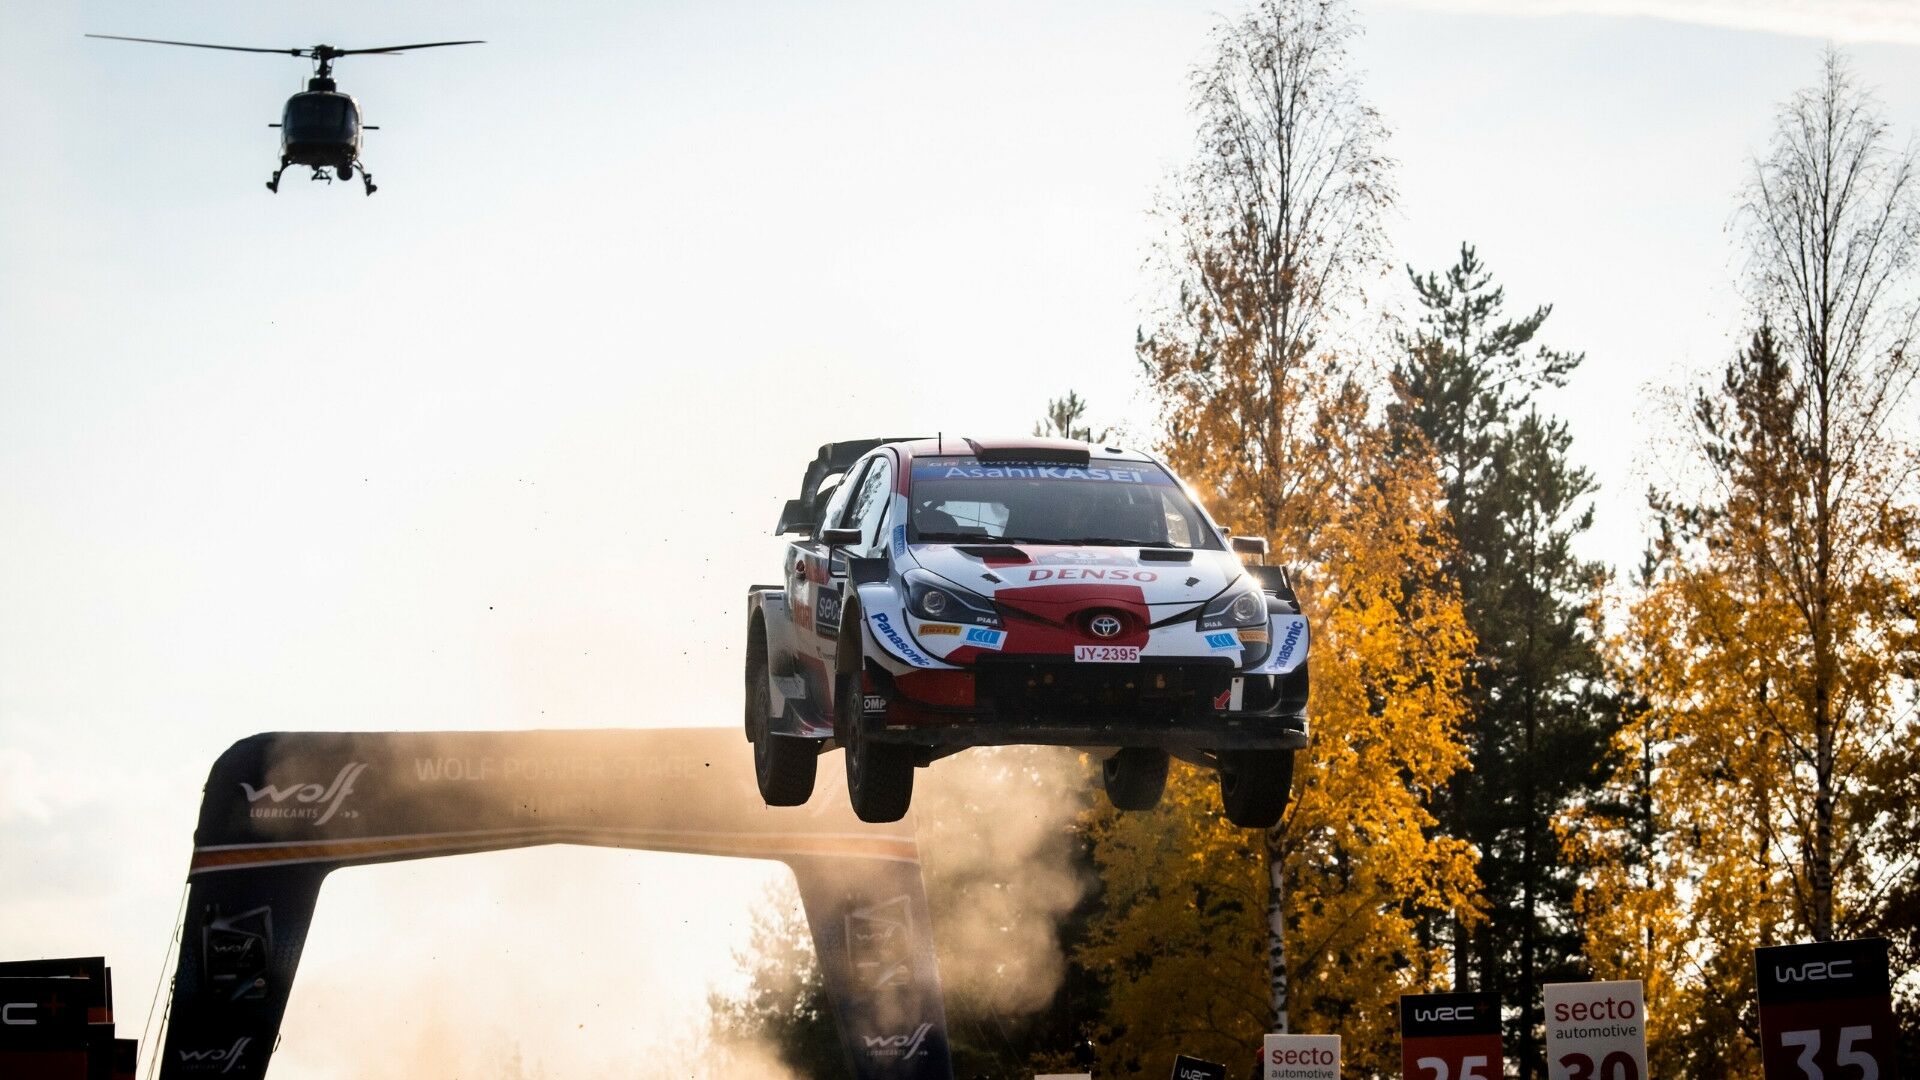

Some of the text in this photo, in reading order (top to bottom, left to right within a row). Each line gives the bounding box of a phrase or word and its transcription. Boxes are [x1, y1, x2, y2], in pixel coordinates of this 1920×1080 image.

[1028, 568, 1158, 583] DENSO
[976, 616, 999, 625] PIAA
[1204, 620, 1223, 628] PIAA
[871, 612, 931, 667] Panasonic
[1267, 621, 1304, 673] Panasonic
[1077, 647, 1138, 661] JY-2395
[863, 699, 887, 709] OMP
[415, 757, 495, 781] WOLF
[503, 757, 605, 780] POWER
[249, 808, 319, 819] LUBRICANTS
[1776, 960, 1853, 983] WRC
[1414, 1006, 1475, 1022] WRC
[1555, 997, 1636, 1022] secto
[1556, 1024, 1637, 1040] automotive
[1271, 1047, 1334, 1066] secto
[1781, 1025, 1879, 1080] 35
[1559, 1051, 1639, 1080] 30
[1271, 1068, 1334, 1080] automotive
